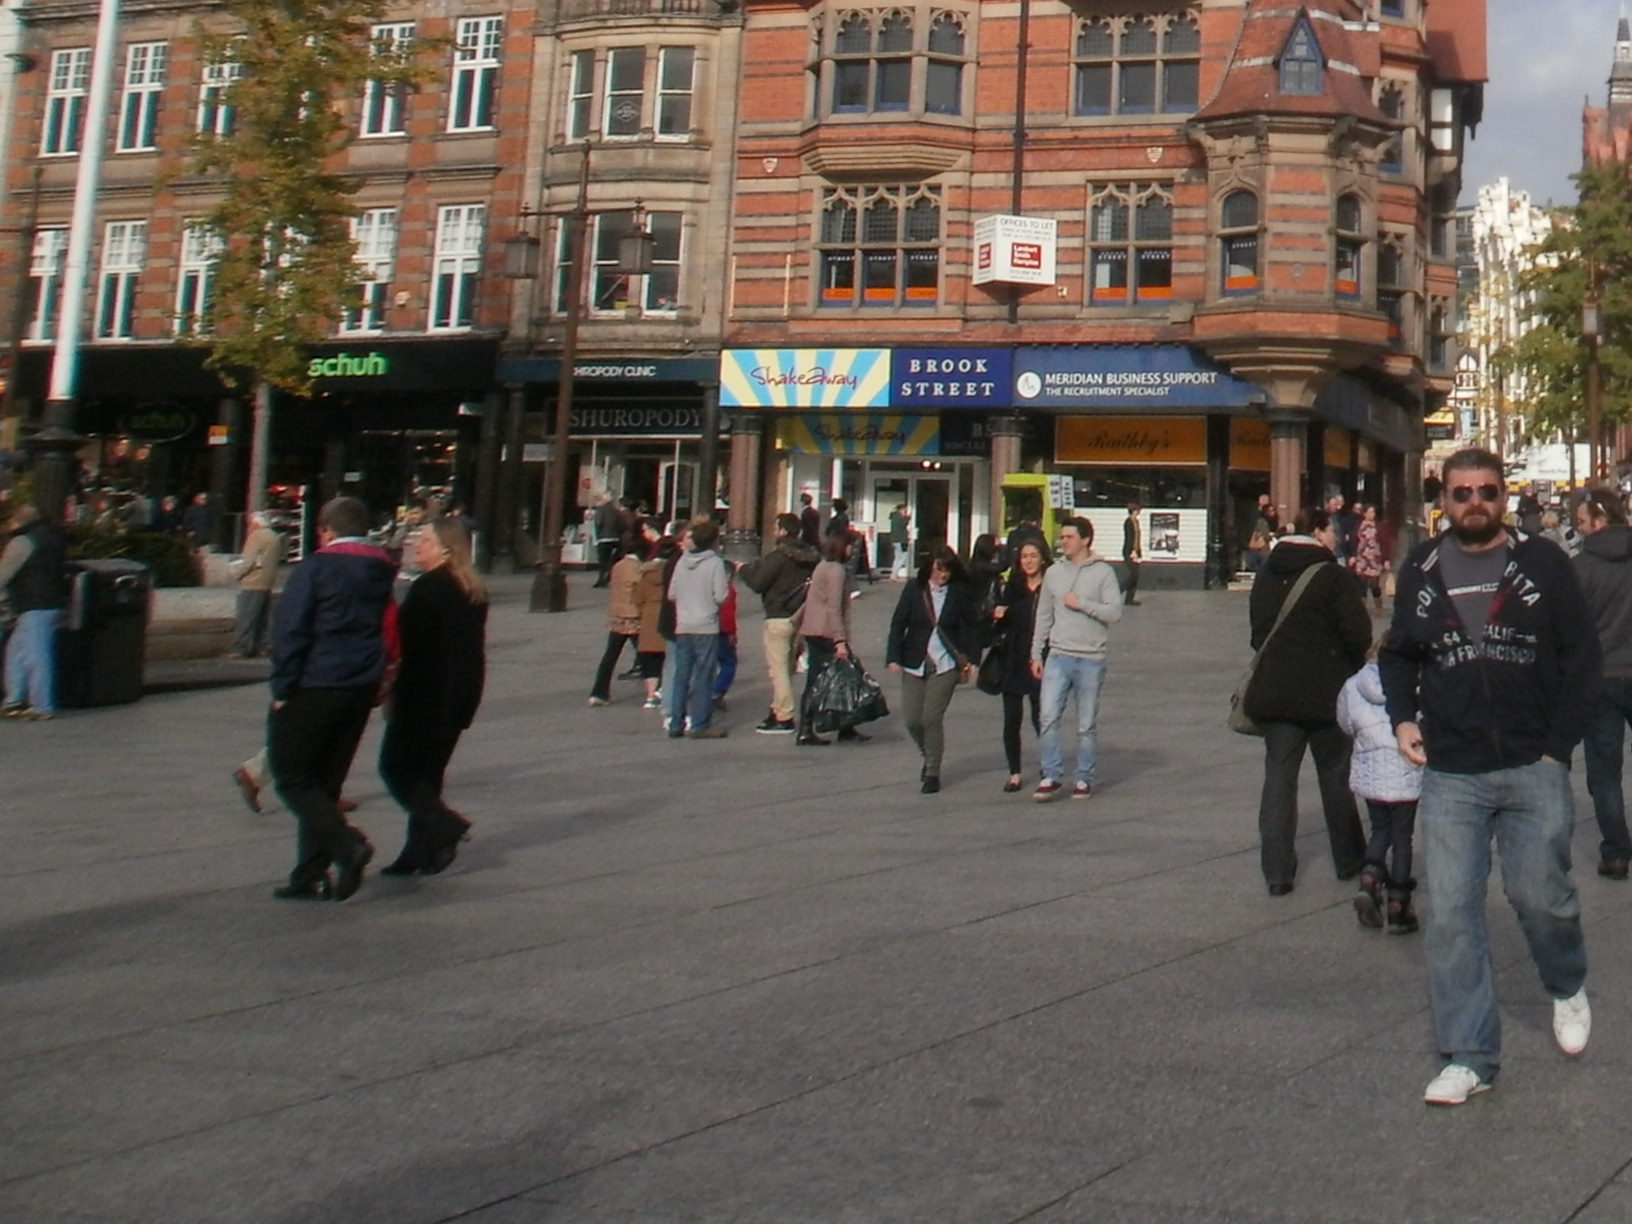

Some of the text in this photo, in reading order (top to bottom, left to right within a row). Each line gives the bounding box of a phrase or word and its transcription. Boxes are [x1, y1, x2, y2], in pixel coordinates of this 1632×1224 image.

[307, 352, 387, 376] schuh
[624, 365, 657, 377] CLINIC
[911, 359, 989, 373] BROOK
[1045, 372, 1218, 385] MERIDIAN BUSINESS SUPPORT
[901, 382, 995, 397] STREET
[1046, 386, 1170, 396] THE RECRUITMENT SPECIALIST
[569, 408, 700, 427] SHUROPODY
